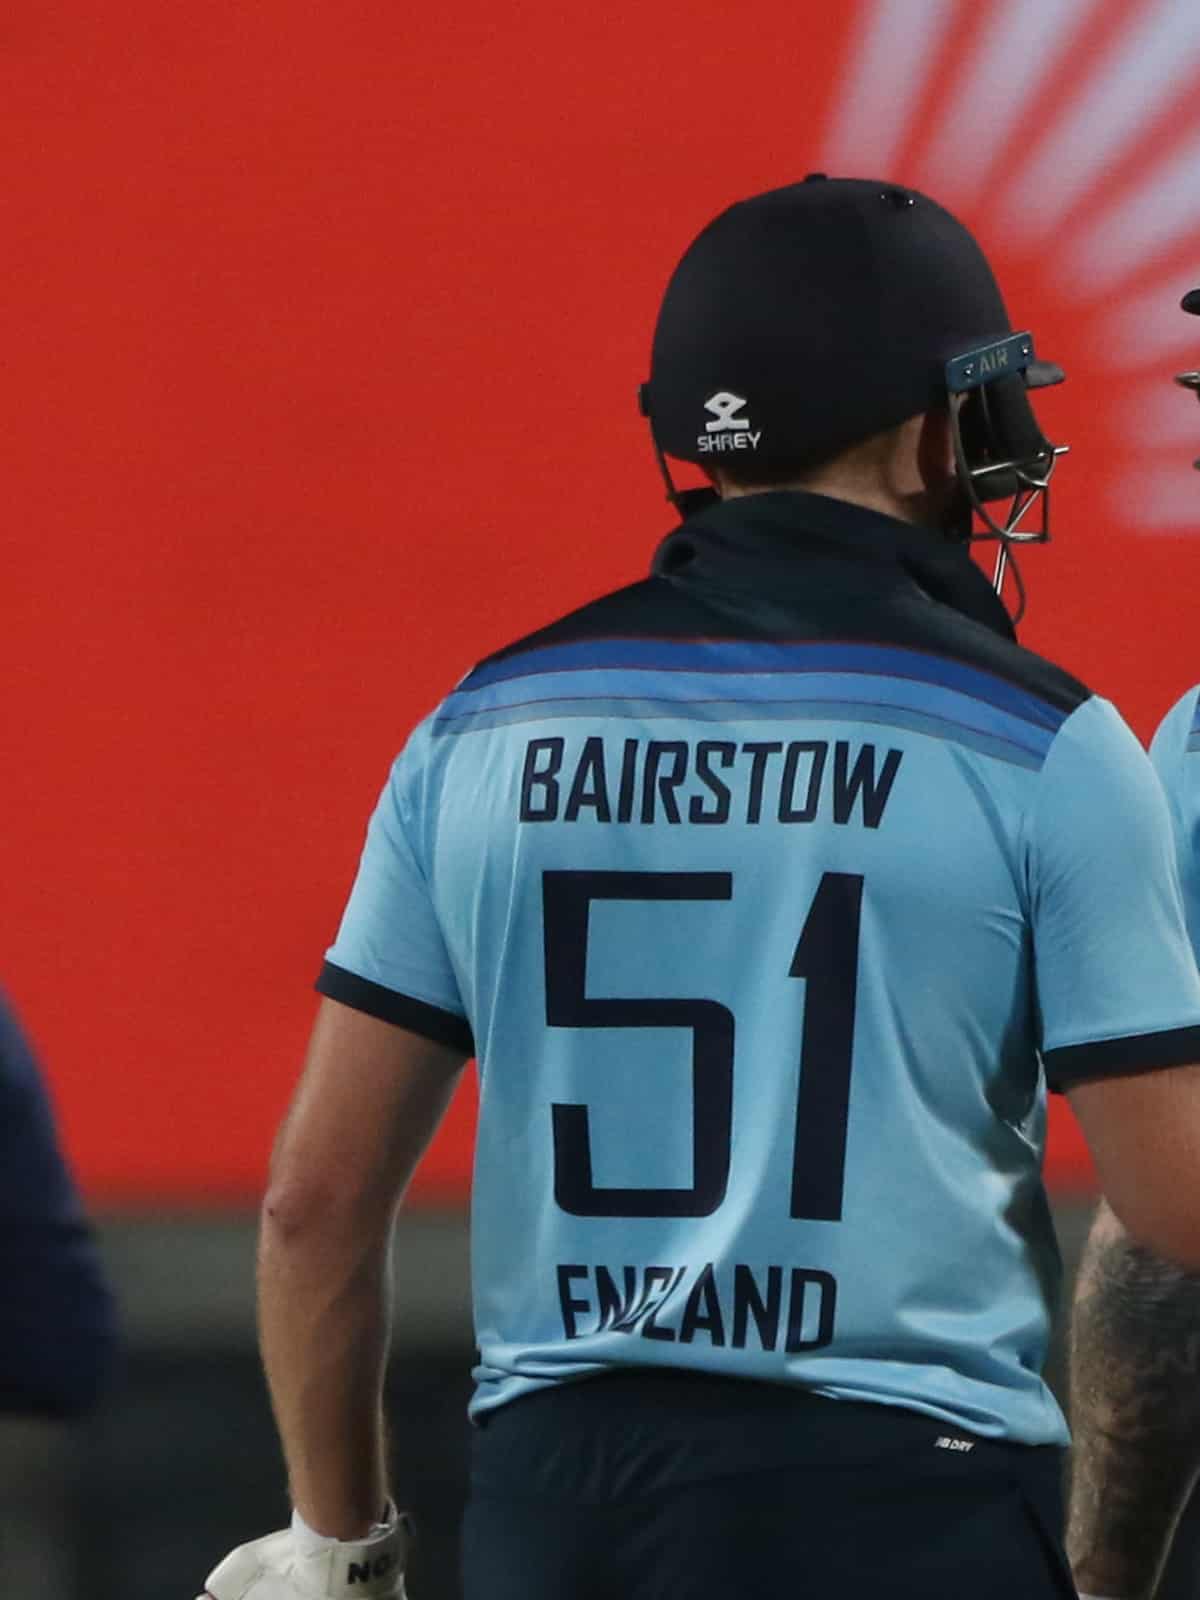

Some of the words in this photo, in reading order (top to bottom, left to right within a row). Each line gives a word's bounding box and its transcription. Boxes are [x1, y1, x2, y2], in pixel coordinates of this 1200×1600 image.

[980, 346, 1009, 376] AIR
[697, 431, 761, 452] SHREY
[519, 736, 904, 829] BAIRSTOW
[542, 870, 865, 1222] 51
